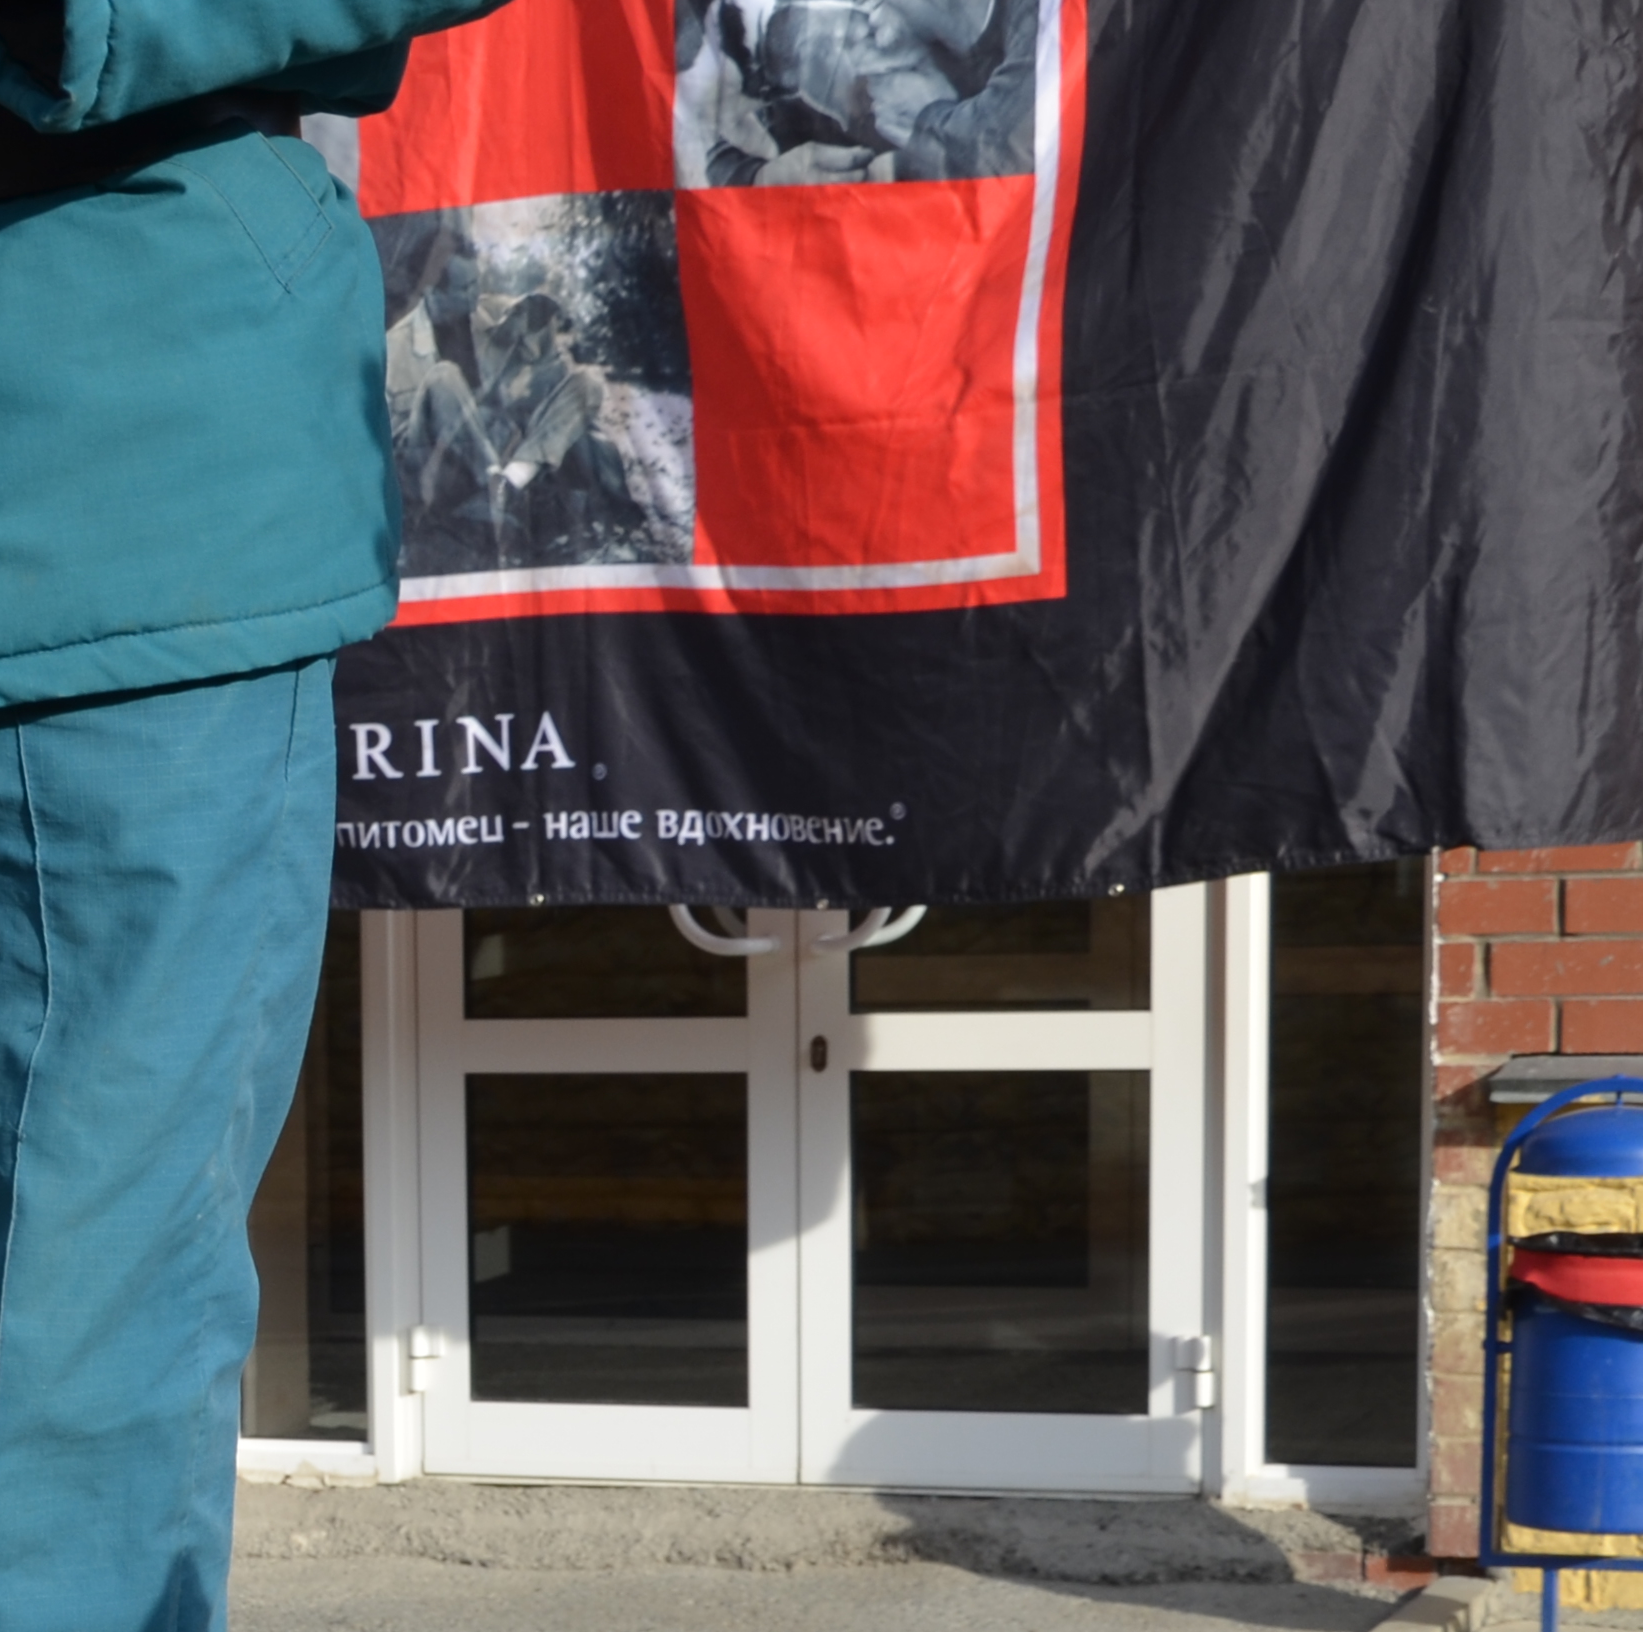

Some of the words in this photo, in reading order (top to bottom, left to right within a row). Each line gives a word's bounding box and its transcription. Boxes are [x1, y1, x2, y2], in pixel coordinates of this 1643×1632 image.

[349, 710, 576, 780] RINA
[336, 814, 505, 849] питомец
[544, 809, 643, 840] наше
[656, 809, 895, 846] вдохновение.
